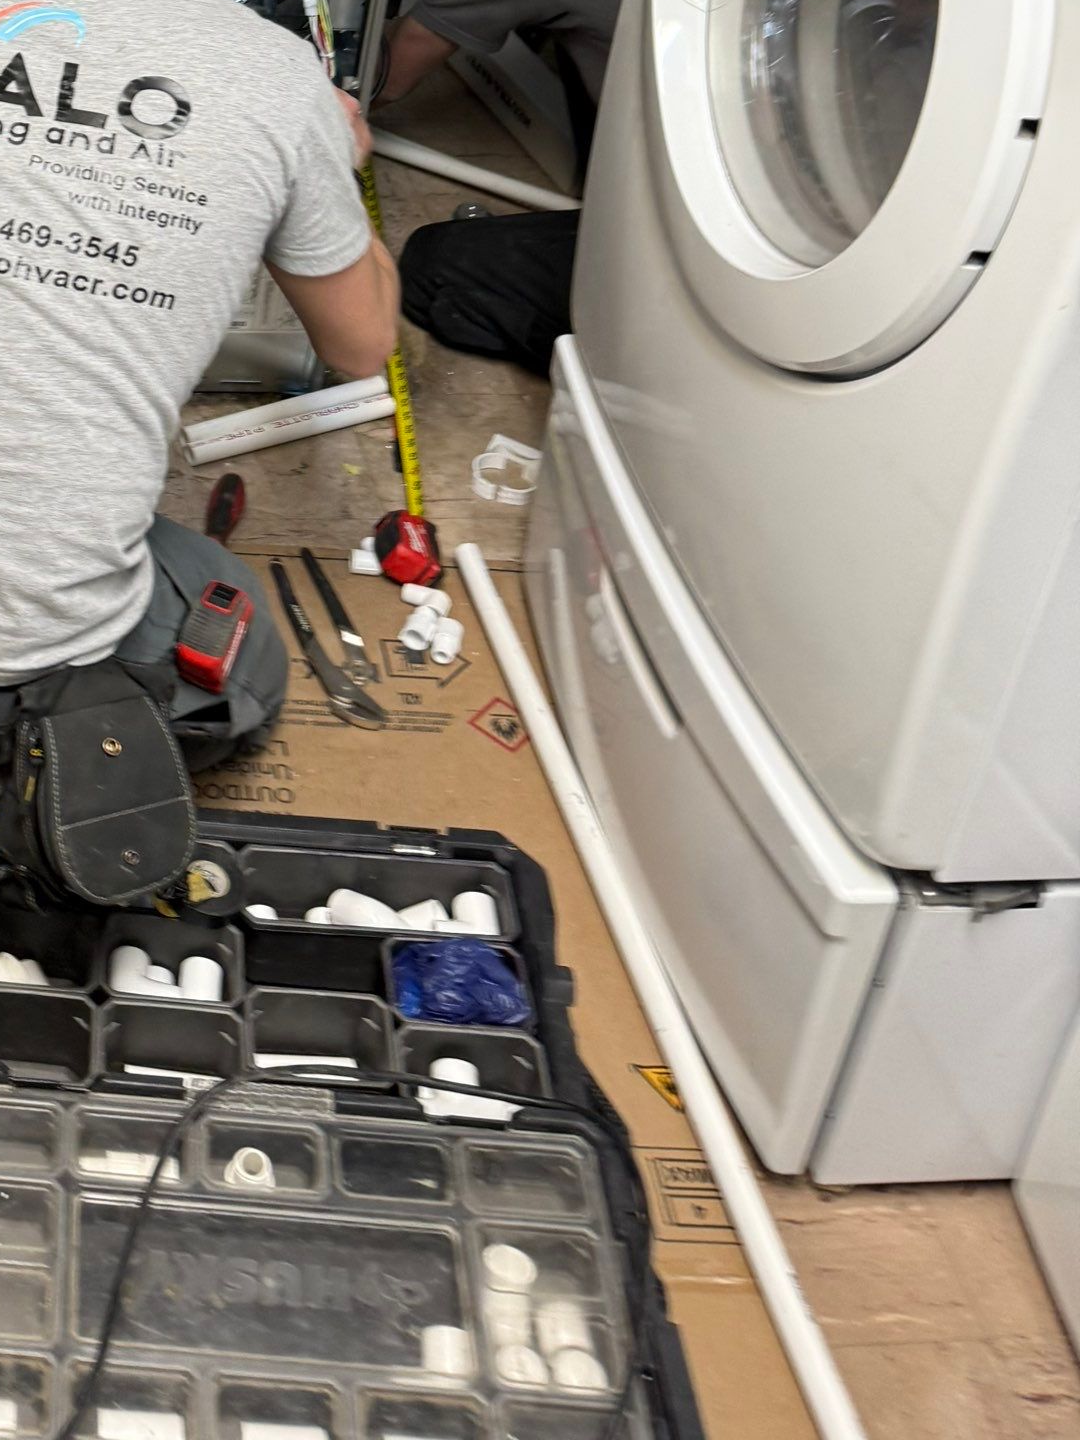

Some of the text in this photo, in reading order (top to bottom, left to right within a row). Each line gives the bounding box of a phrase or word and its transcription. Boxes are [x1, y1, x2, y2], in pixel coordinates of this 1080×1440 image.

[45, 125, 117, 155] and
[130, 139, 186, 167] Air
[28, 154, 208, 206] Providing Service
[68, 191, 204, 235] with Integrity
[193, 782, 296, 804] OUTDO
